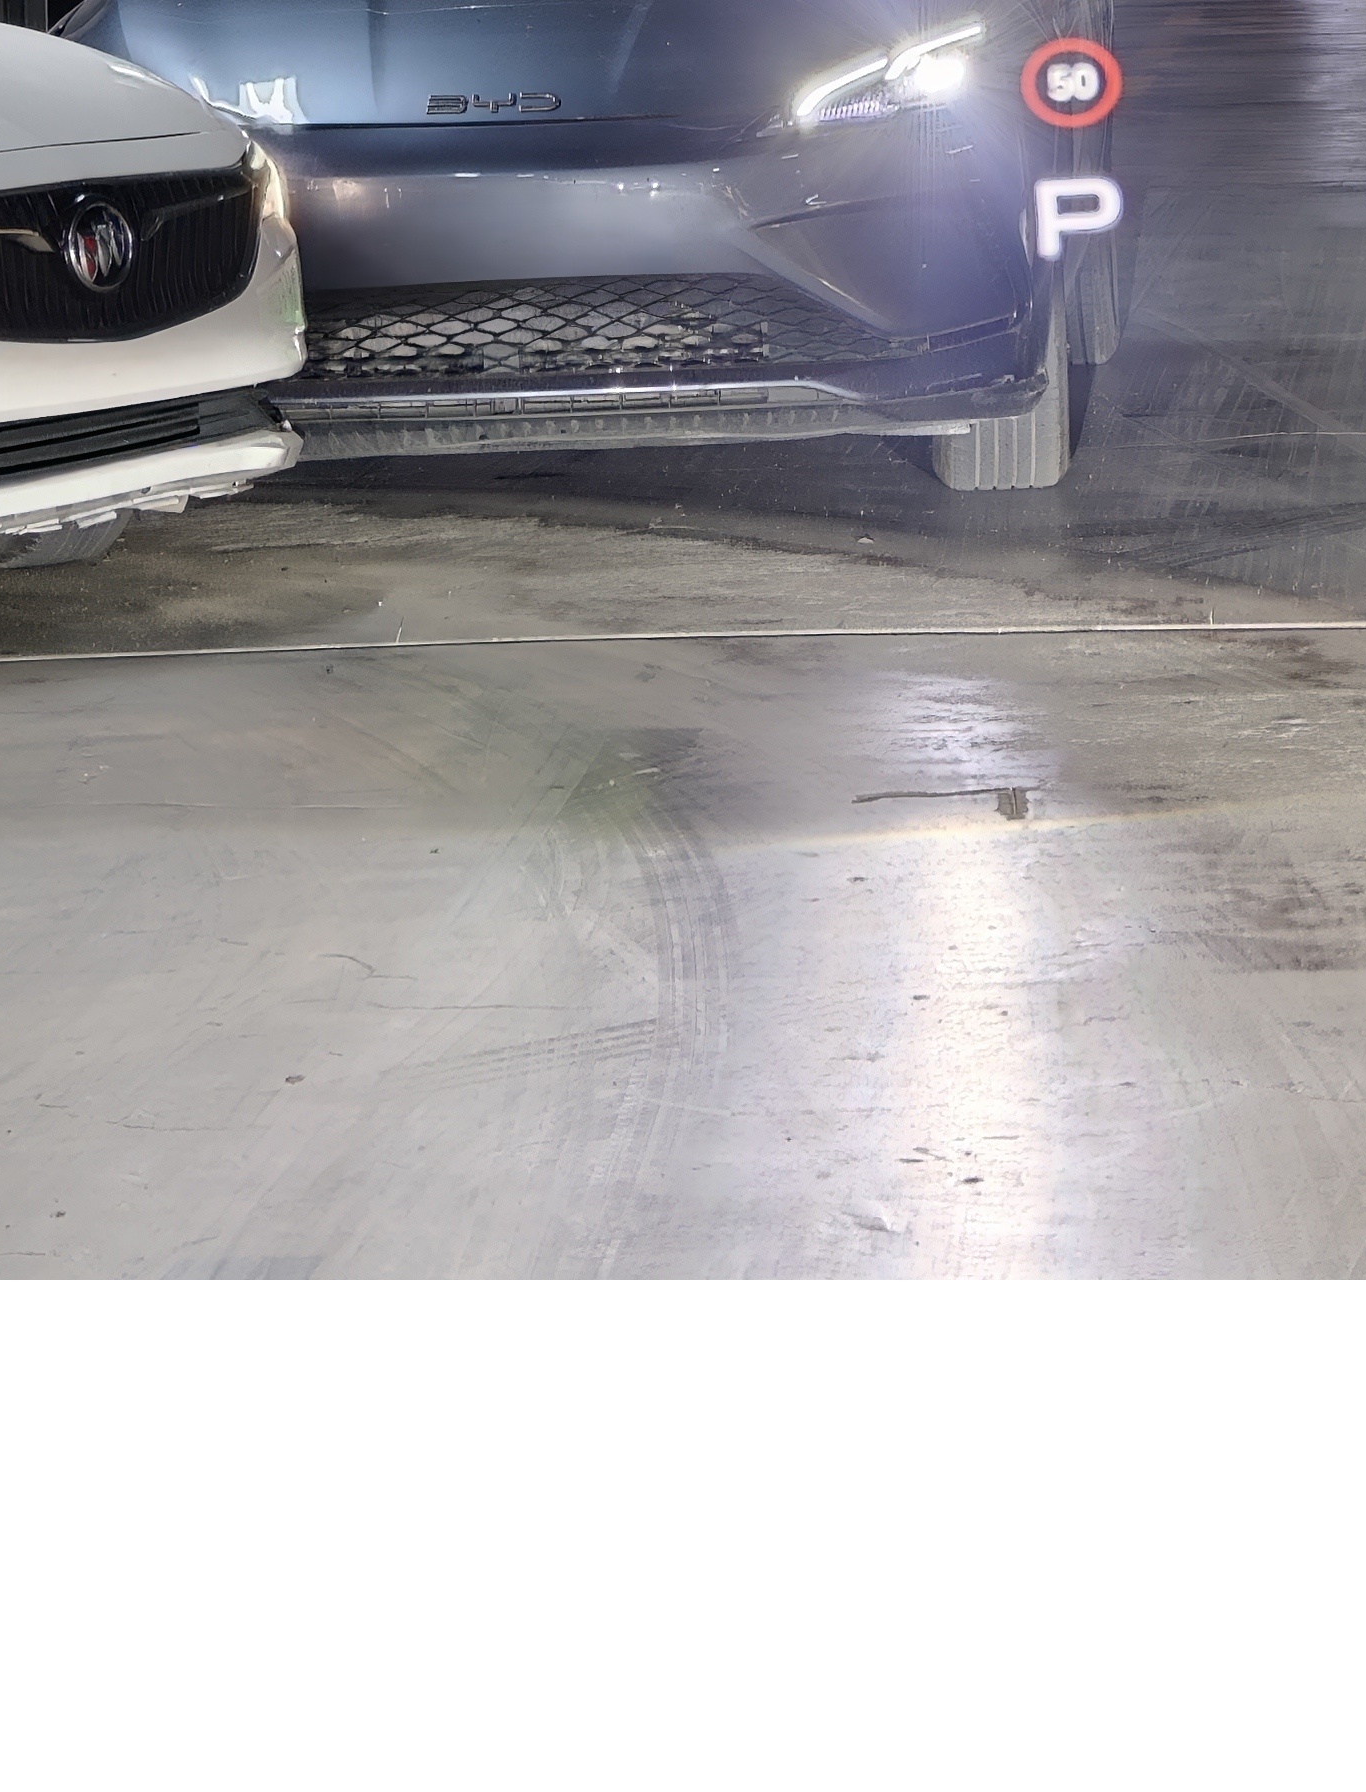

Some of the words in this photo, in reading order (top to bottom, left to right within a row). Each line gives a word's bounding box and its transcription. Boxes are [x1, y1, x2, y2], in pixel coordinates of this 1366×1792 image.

[1046, 62, 1100, 102] 50
[426, 92, 561, 115] BYD
[1035, 178, 1123, 261] P
